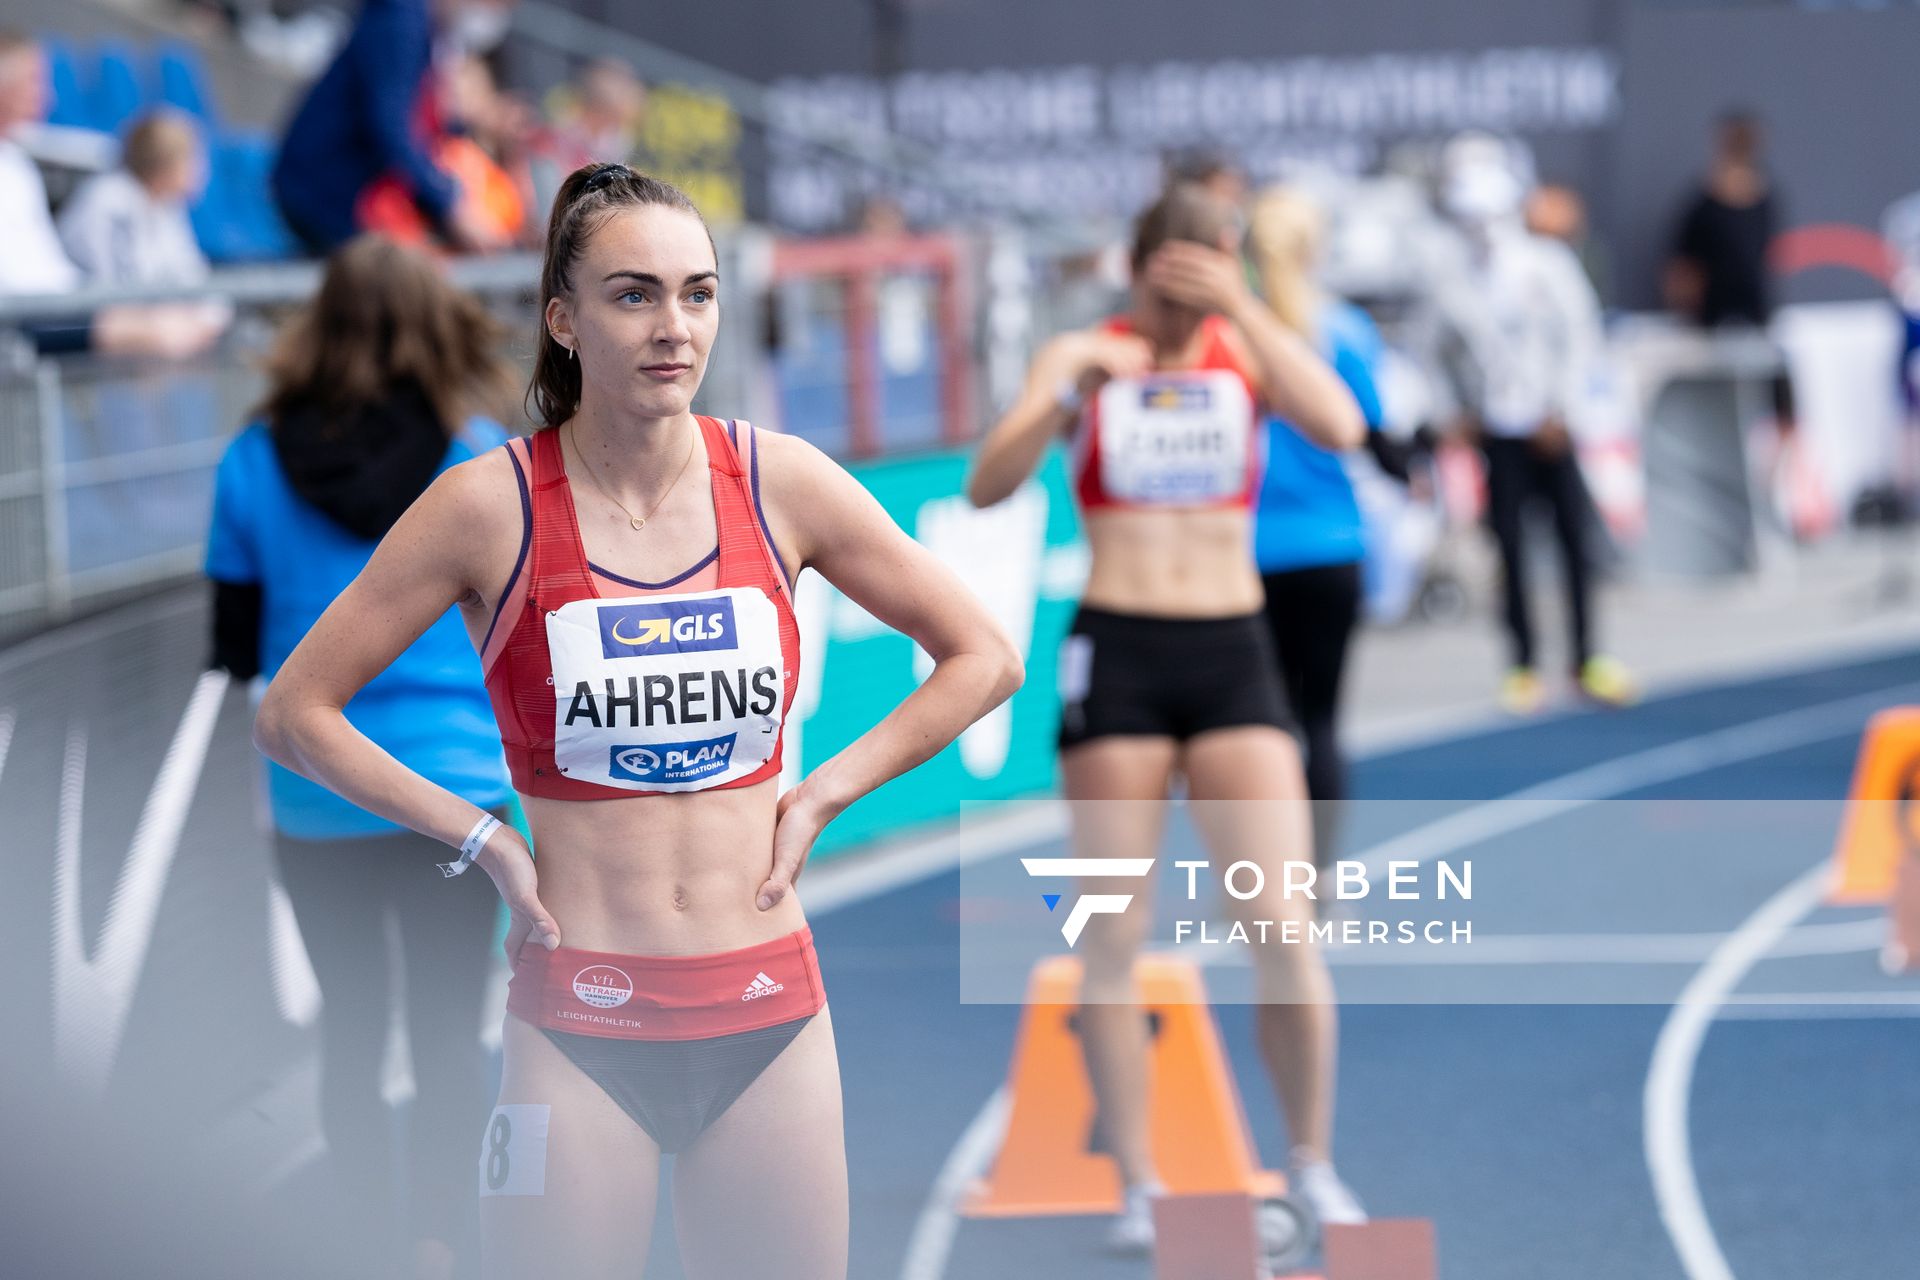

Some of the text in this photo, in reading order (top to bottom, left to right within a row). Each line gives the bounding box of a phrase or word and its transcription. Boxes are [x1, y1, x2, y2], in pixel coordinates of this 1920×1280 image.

[672, 613, 724, 642] GLS
[564, 665, 777, 728] AHRENS
[665, 742, 730, 769] PLAN
[665, 760, 725, 778] INTERNATIONAL
[592, 974, 617, 987] VfL
[575, 984, 629, 998] EINTRACHT
[584, 992, 618, 1001] HANNOVER
[741, 983, 784, 1001] adidas
[557, 1010, 642, 1028] LEICHTATHLETIK
[487, 1113, 511, 1190] 8
